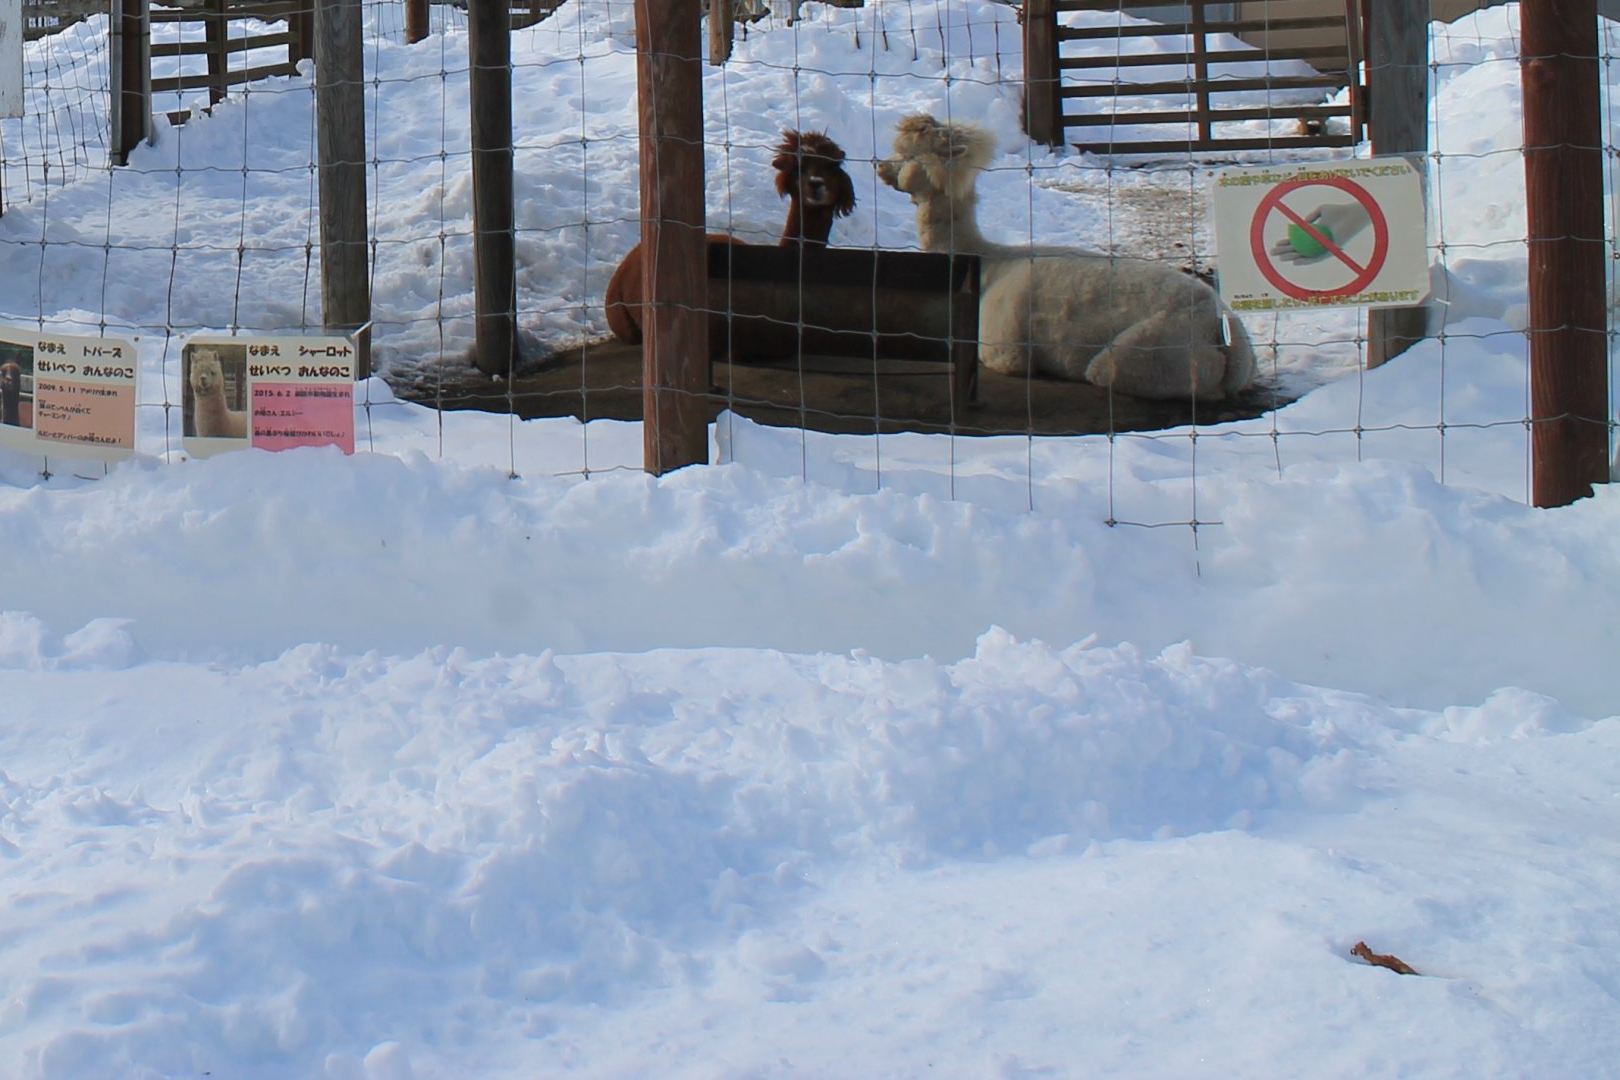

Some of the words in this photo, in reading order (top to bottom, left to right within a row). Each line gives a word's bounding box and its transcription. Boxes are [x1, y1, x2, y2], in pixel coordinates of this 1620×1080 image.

[37, 340, 67, 355] なまえ
[83, 345, 123, 359] トパーズ
[248, 345, 281, 357] なまえ
[298, 345, 353, 358] シャーロット
[37, 360, 77, 373] せいべつ
[82, 365, 135, 379] おんなのこ
[248, 365, 292, 377] せいべつ
[297, 366, 351, 378] おんなのこ
